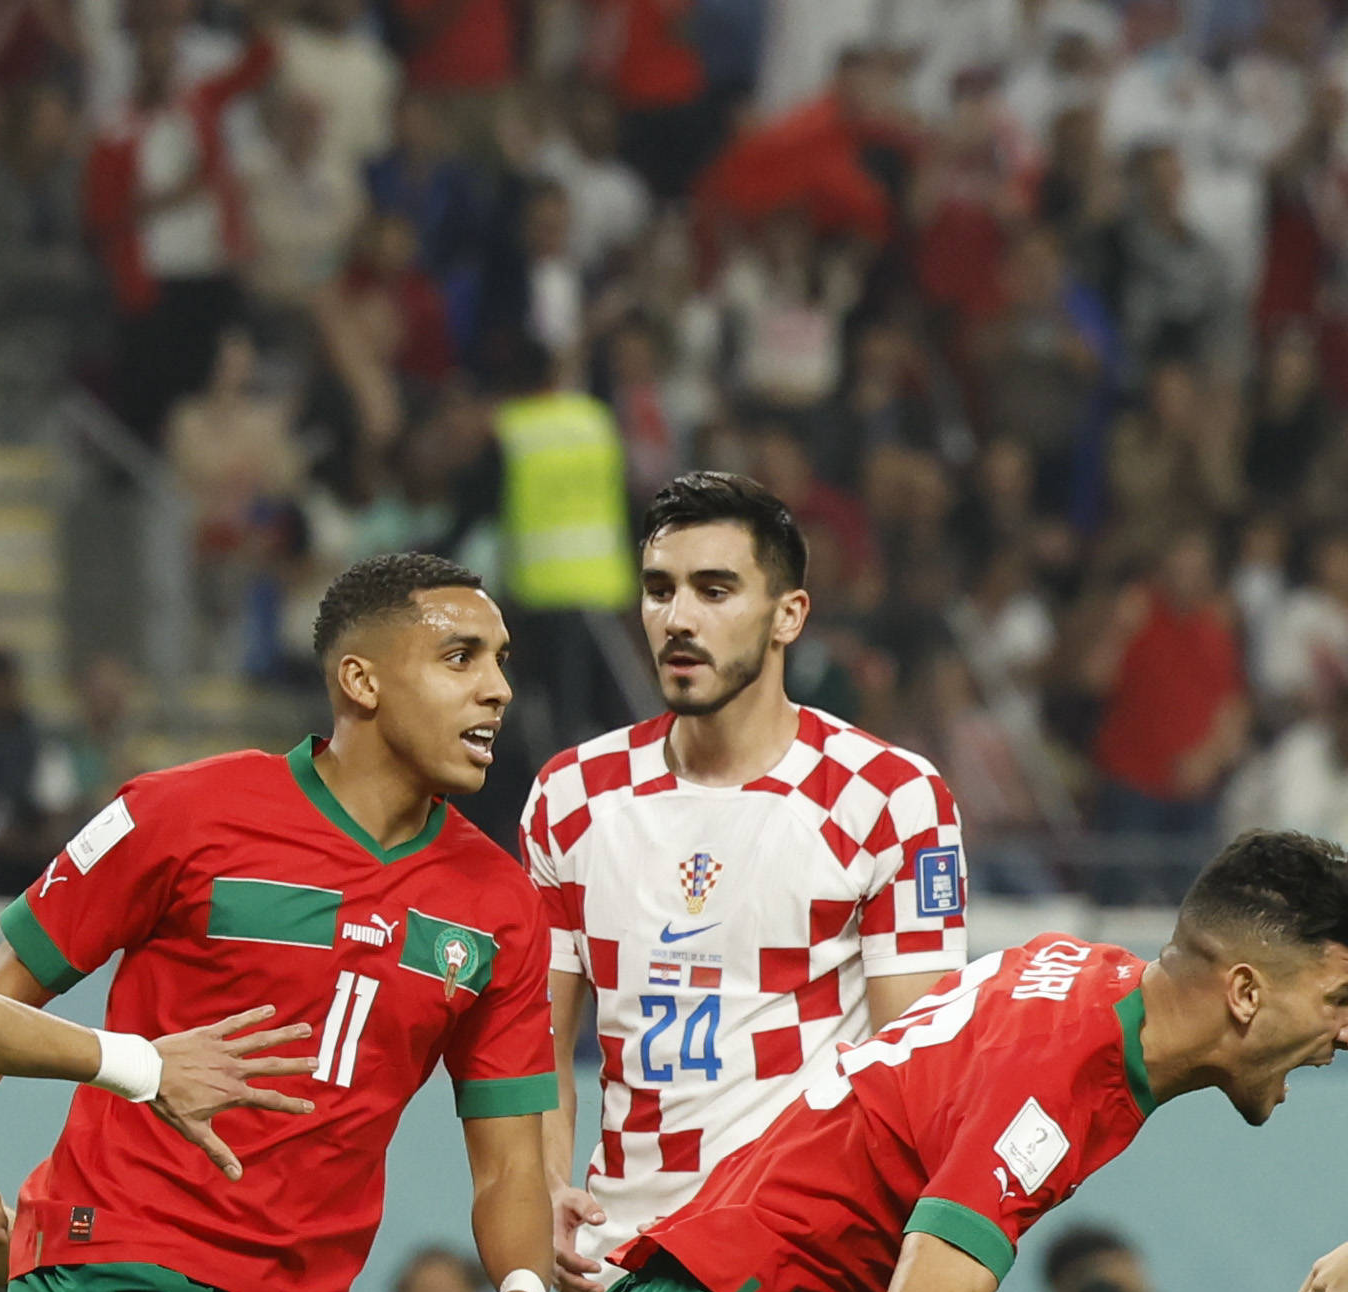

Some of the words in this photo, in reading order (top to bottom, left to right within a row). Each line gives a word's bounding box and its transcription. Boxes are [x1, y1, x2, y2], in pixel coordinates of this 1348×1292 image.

[342, 922, 386, 948] PUMA
[313, 970, 380, 1089] 11
[639, 994, 723, 1082] 24
